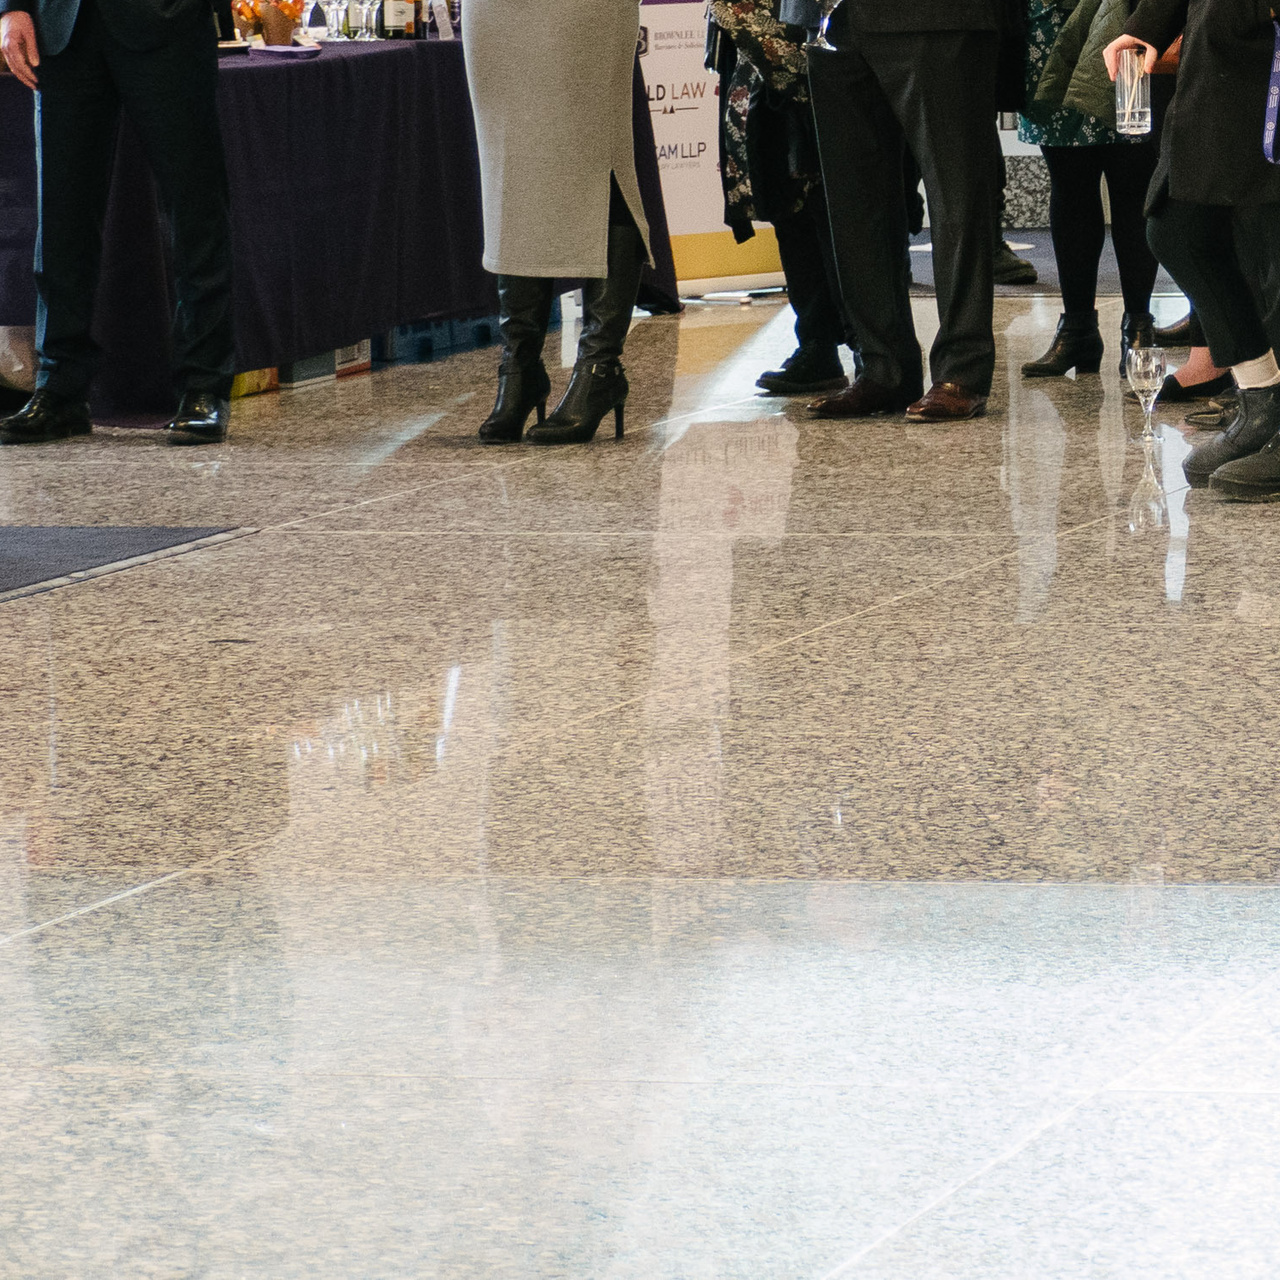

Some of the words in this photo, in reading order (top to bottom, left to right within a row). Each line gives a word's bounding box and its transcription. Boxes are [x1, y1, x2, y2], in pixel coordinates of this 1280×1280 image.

[671, 82, 707, 100] LAW
[656, 143, 678, 160] AM
[681, 142, 707, 158] LLP
